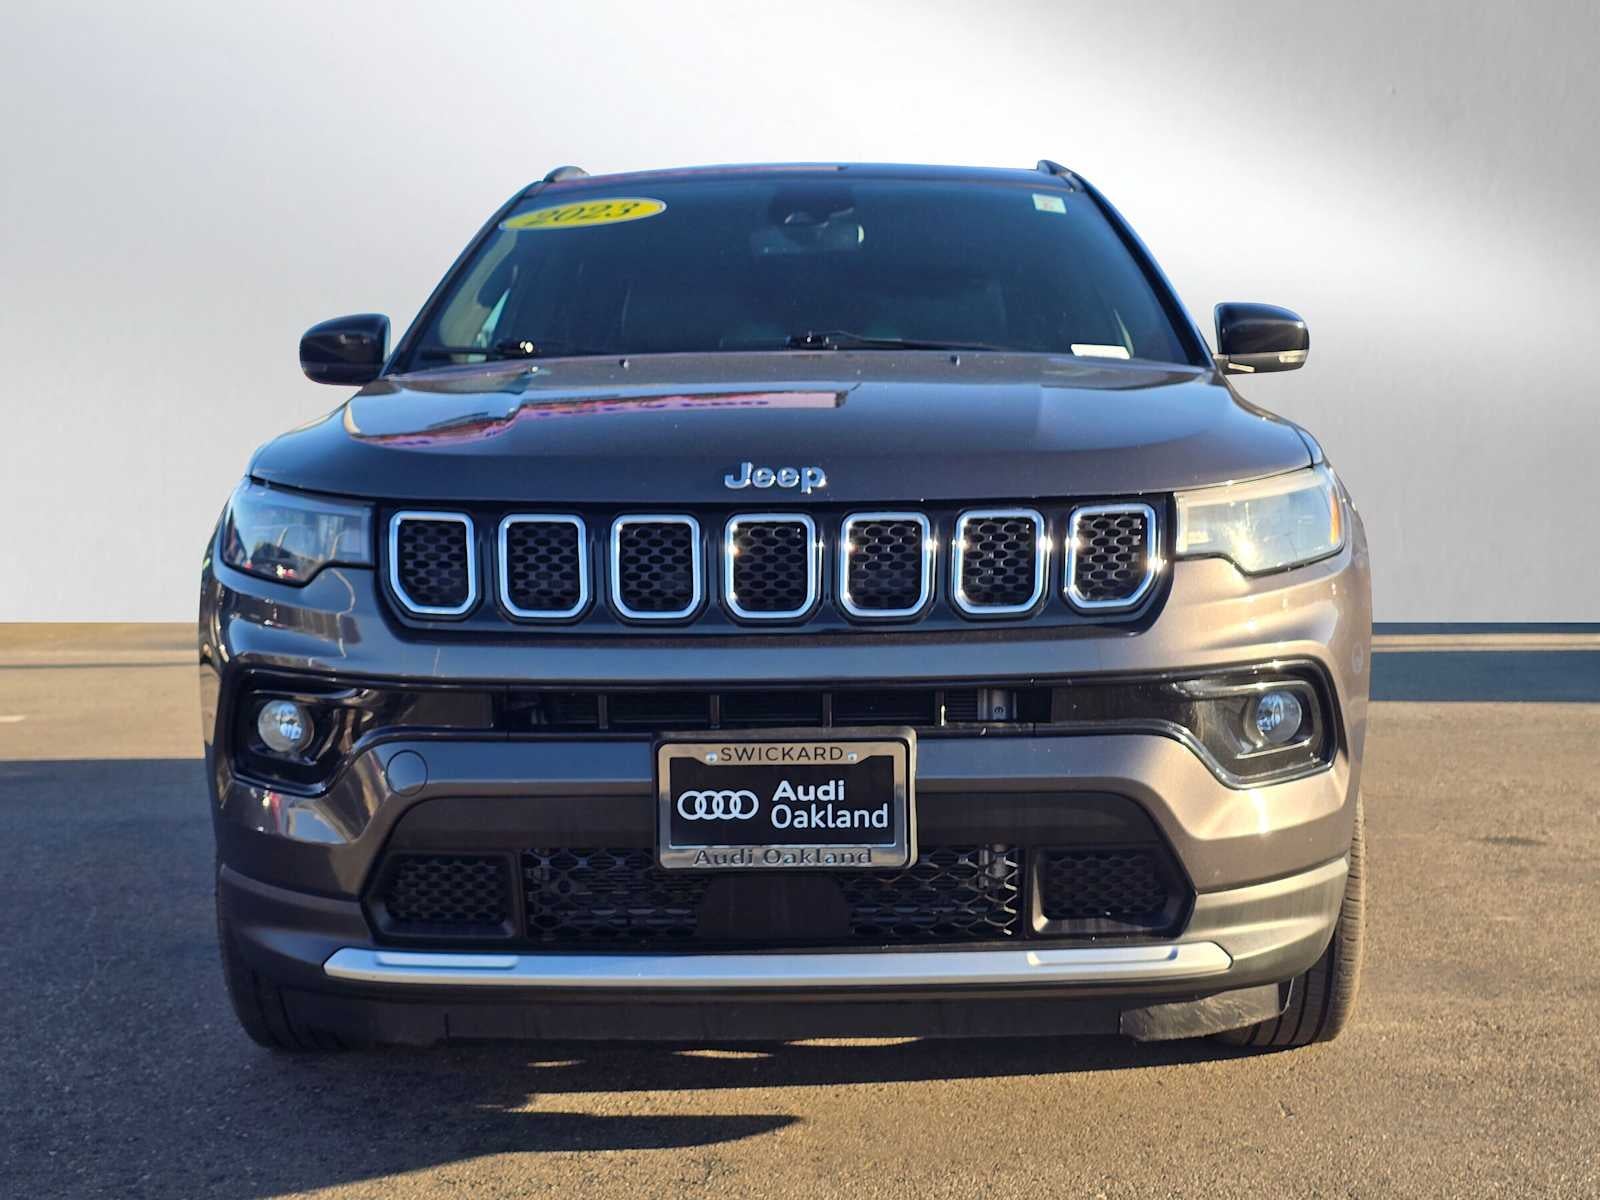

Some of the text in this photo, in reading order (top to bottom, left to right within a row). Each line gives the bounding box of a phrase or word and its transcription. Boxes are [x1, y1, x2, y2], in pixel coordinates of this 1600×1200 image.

[524, 202, 640, 226] 2023
[724, 462, 826, 494] Jeep
[720, 746, 843, 762] SWICKARD
[772, 780, 845, 801] Audi
[771, 803, 888, 829] Oakland
[694, 847, 872, 866] Audi Oakland
